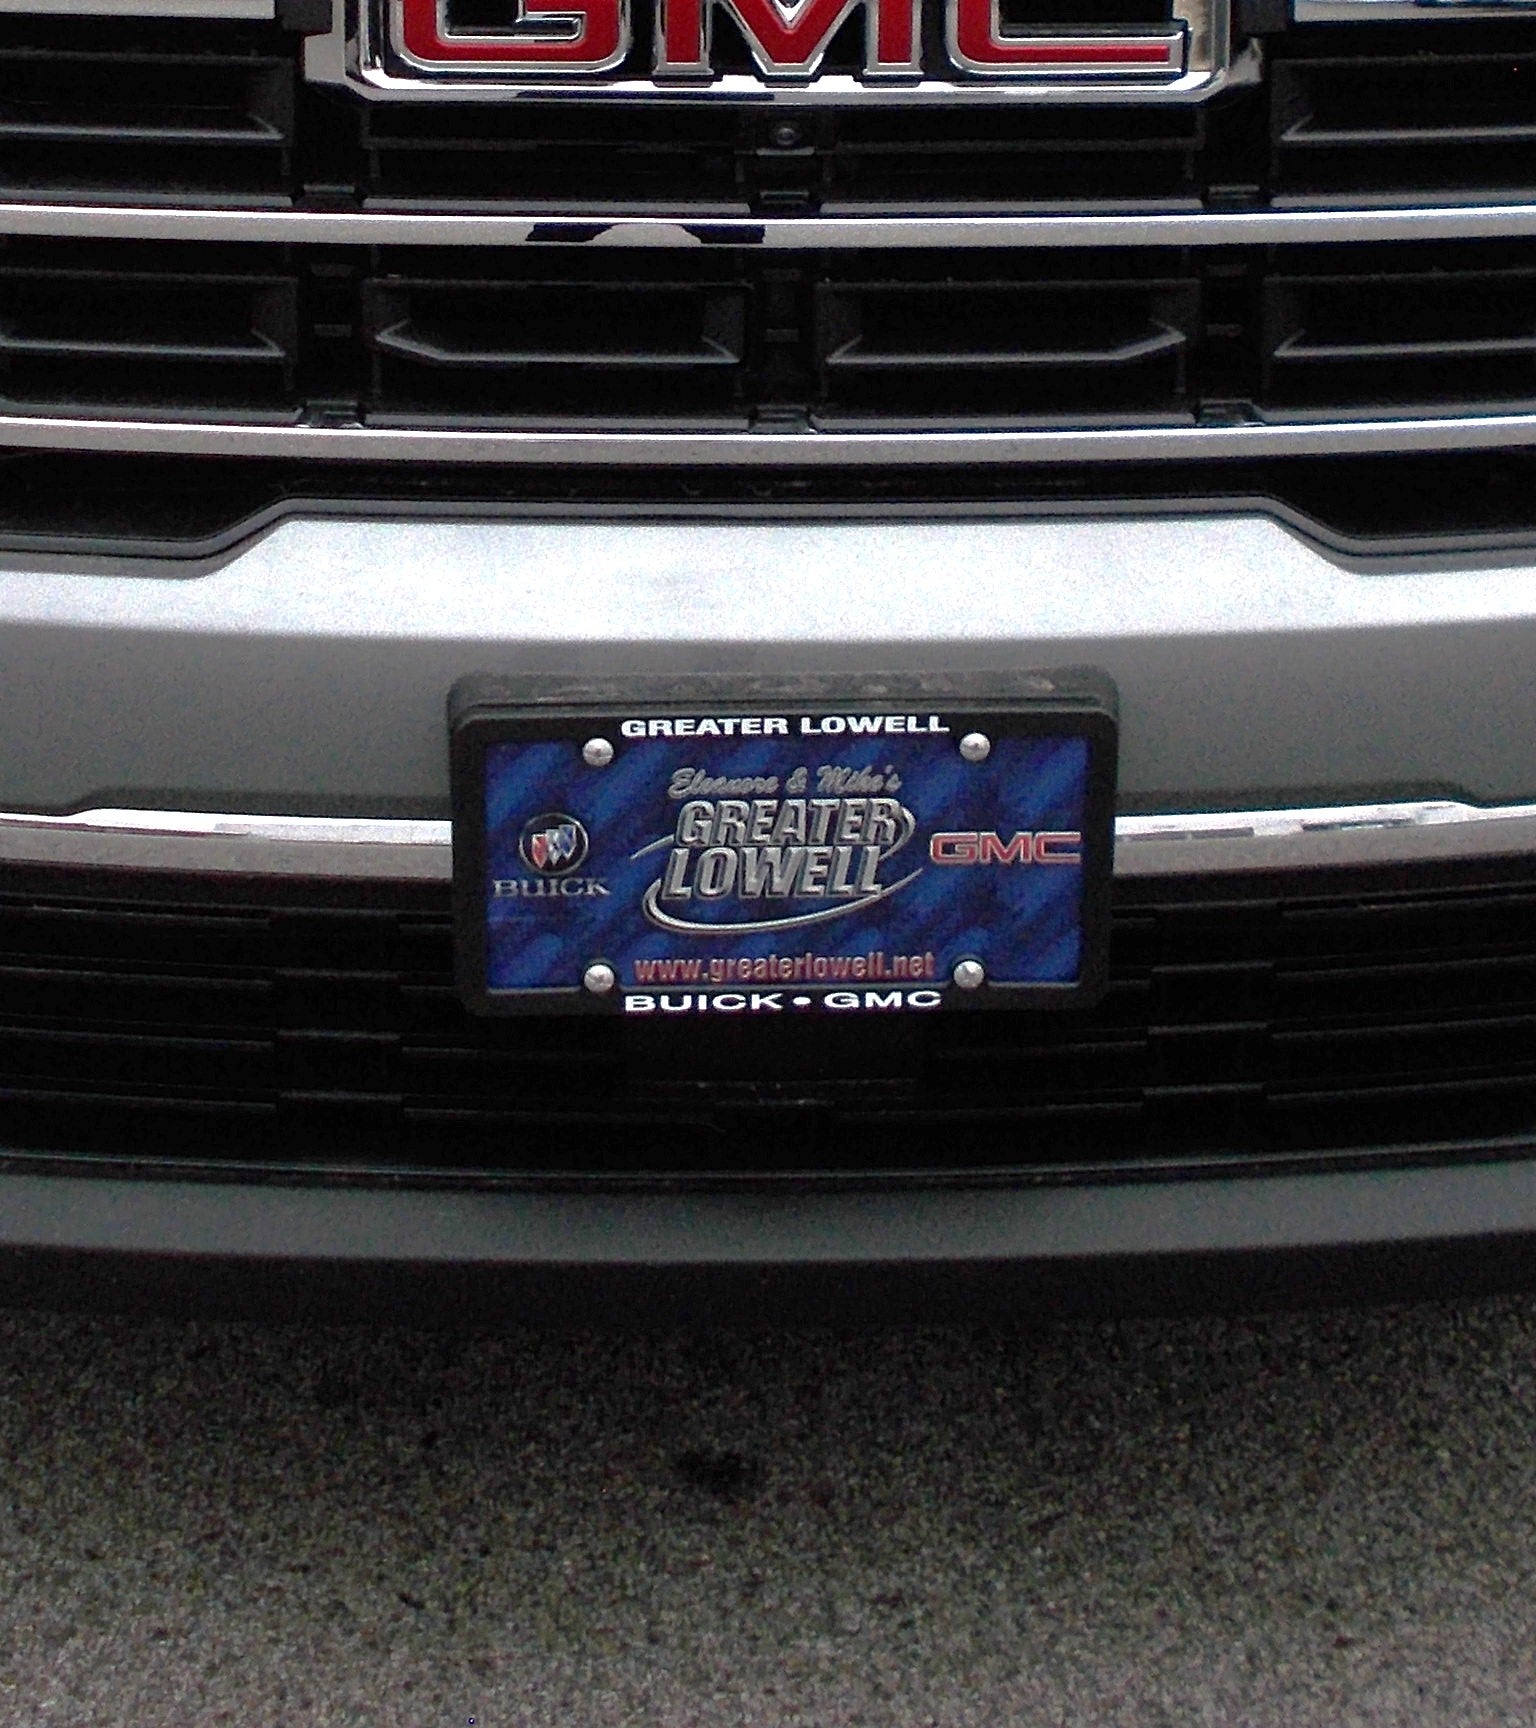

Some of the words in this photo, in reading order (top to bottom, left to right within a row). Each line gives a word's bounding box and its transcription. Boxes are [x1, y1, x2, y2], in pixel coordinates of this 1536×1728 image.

[621, 716, 788, 739] GREATER
[800, 714, 951, 736] LOWELL
[785, 765, 808, 795] &
[816, 763, 902, 795] Mike's
[675, 797, 903, 848] GREATER
[928, 830, 1082, 866] GMC
[492, 877, 611, 898] BUICK
[662, 844, 884, 900] LOWELL
[633, 950, 936, 983] www.greaterlowell.net
[624, 991, 784, 1013] BUICK
[821, 989, 943, 1010] GMC
